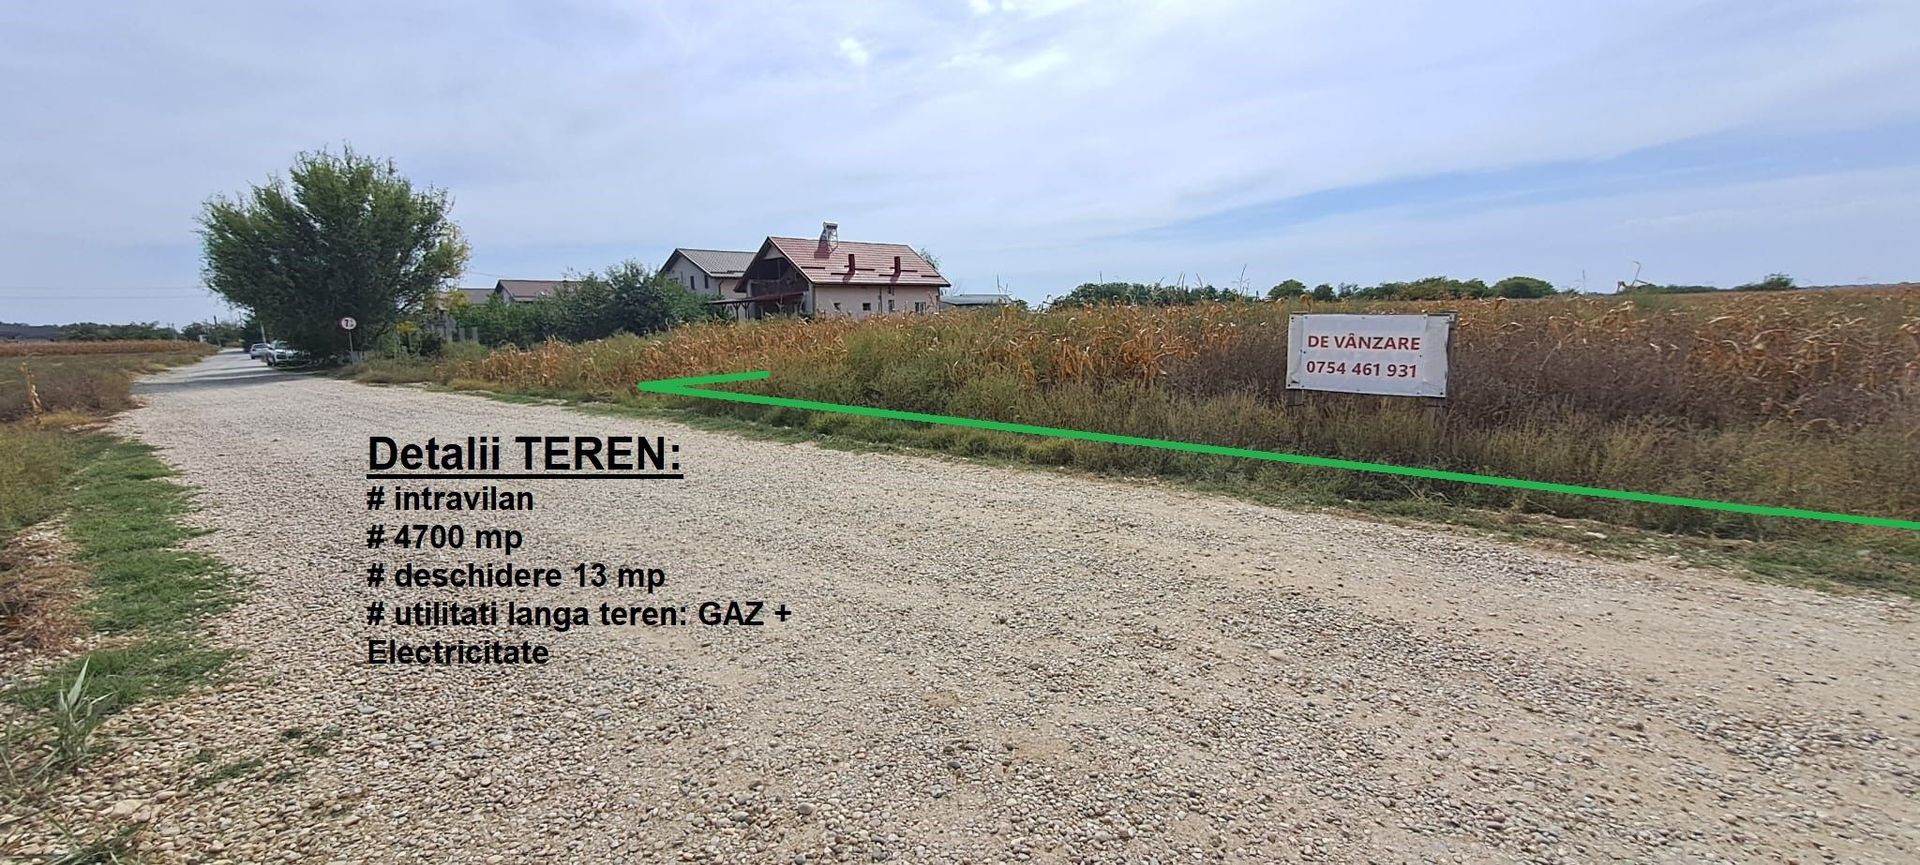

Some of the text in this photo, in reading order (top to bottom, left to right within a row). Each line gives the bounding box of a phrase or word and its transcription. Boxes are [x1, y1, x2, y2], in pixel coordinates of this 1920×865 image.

[1308, 332, 1421, 350] DE VÂNZARE
[1306, 360, 1417, 378] 0754 461 931
